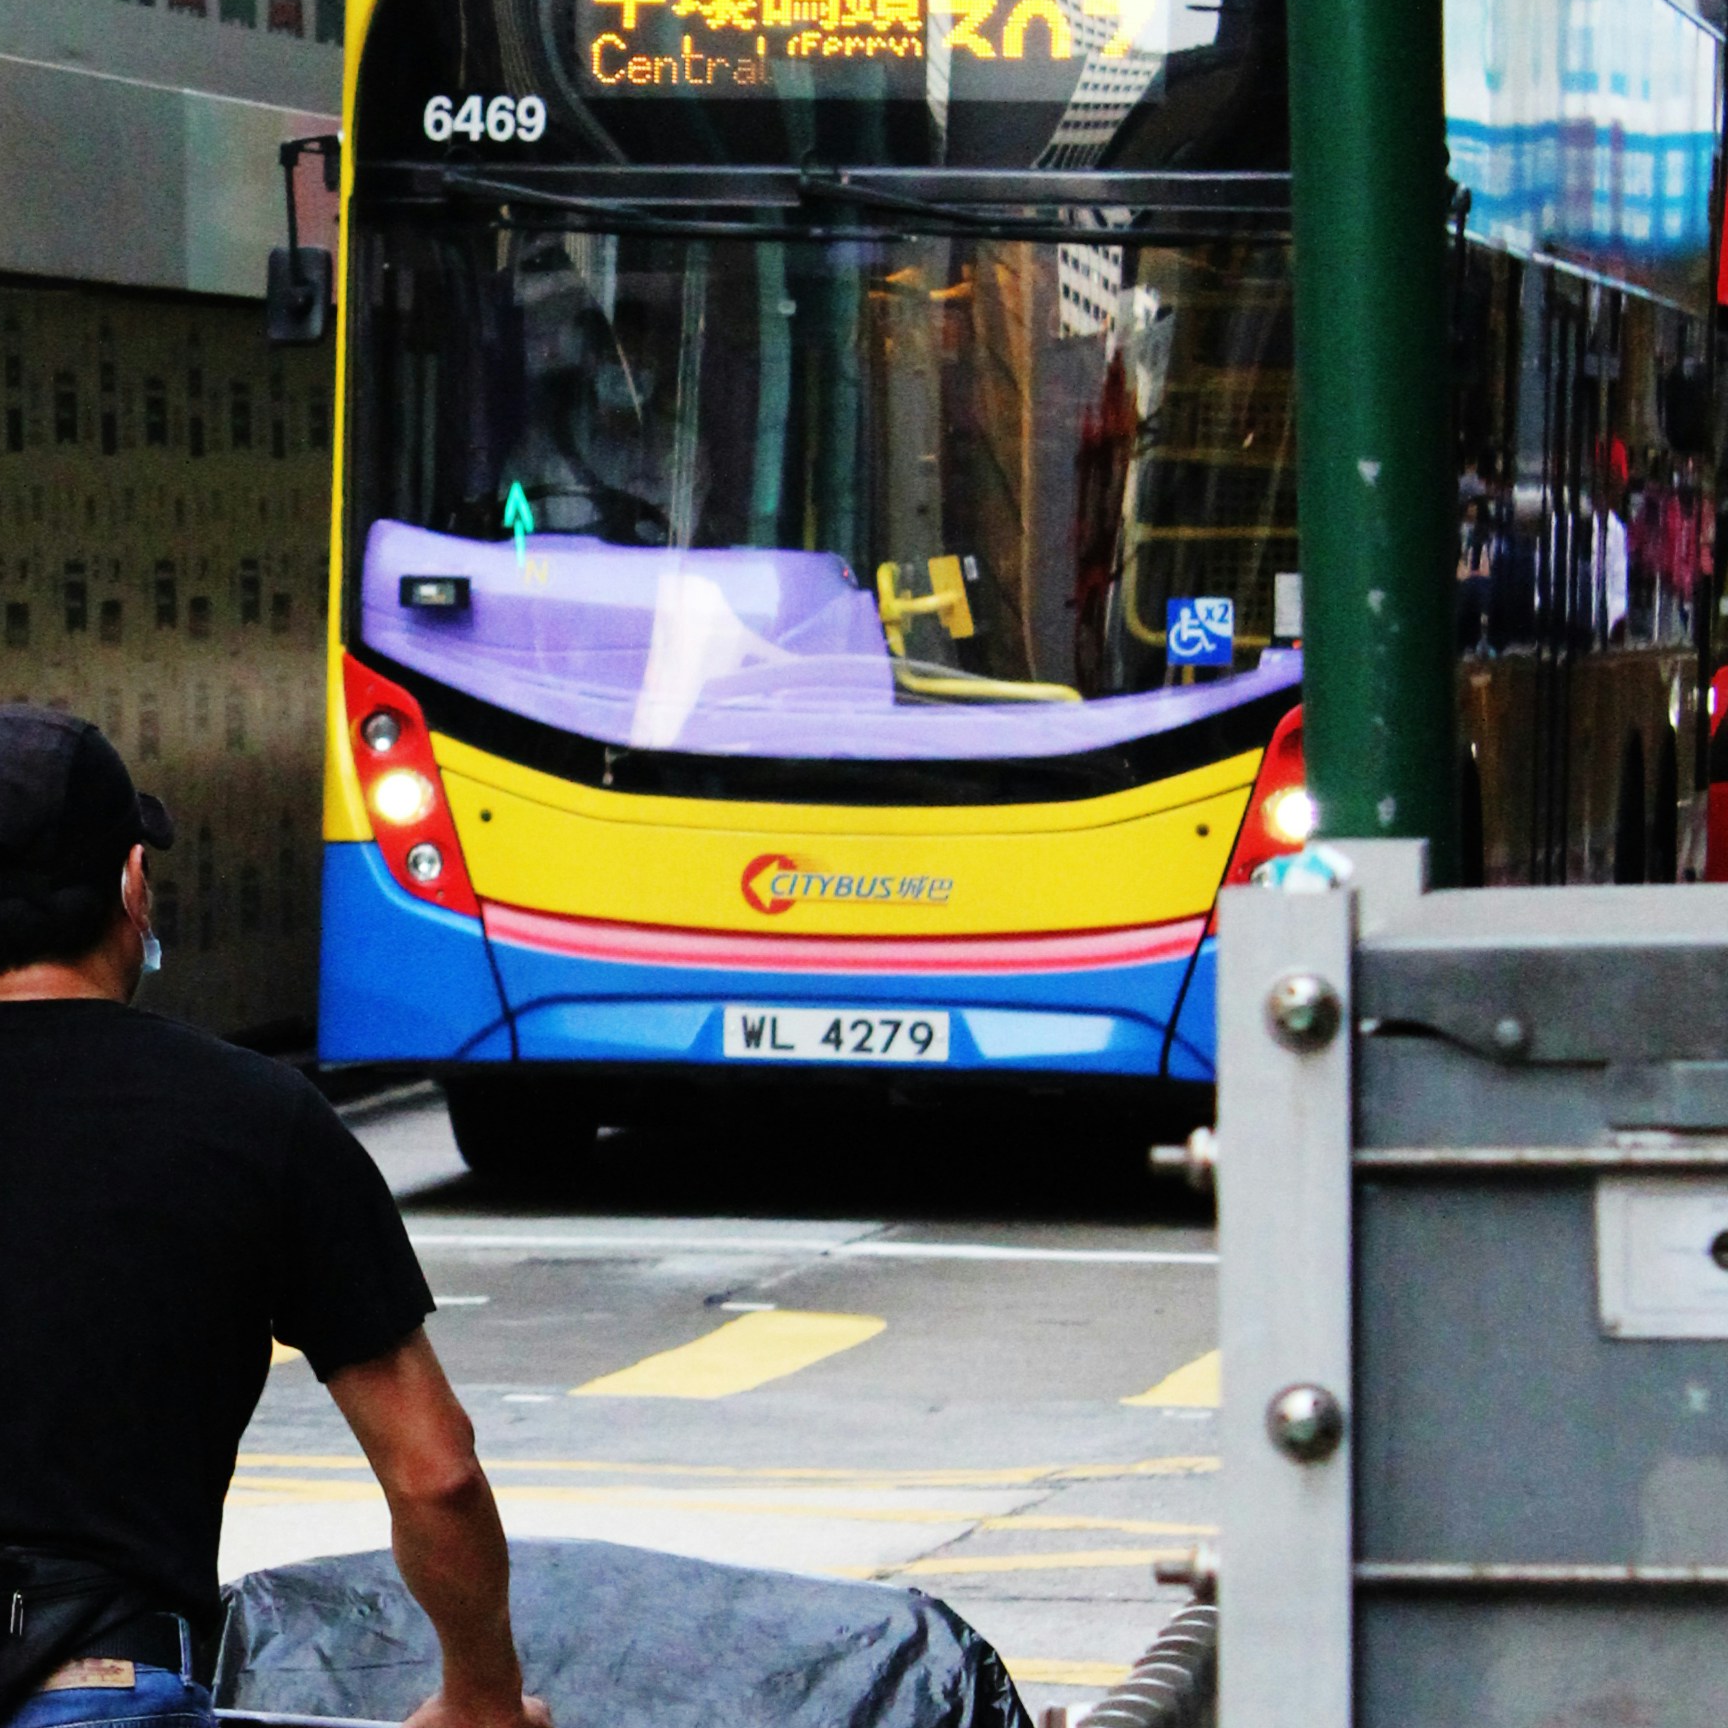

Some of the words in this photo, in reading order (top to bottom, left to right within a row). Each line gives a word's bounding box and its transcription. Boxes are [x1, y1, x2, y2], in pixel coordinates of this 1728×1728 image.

[591, 32, 772, 85] Central
[423, 94, 547, 143] 6469
[769, 872, 895, 899] CITYBUS
[897, 875, 954, 902] 城巴
[741, 1014, 795, 1051] WL
[820, 1017, 935, 1056] 4279
